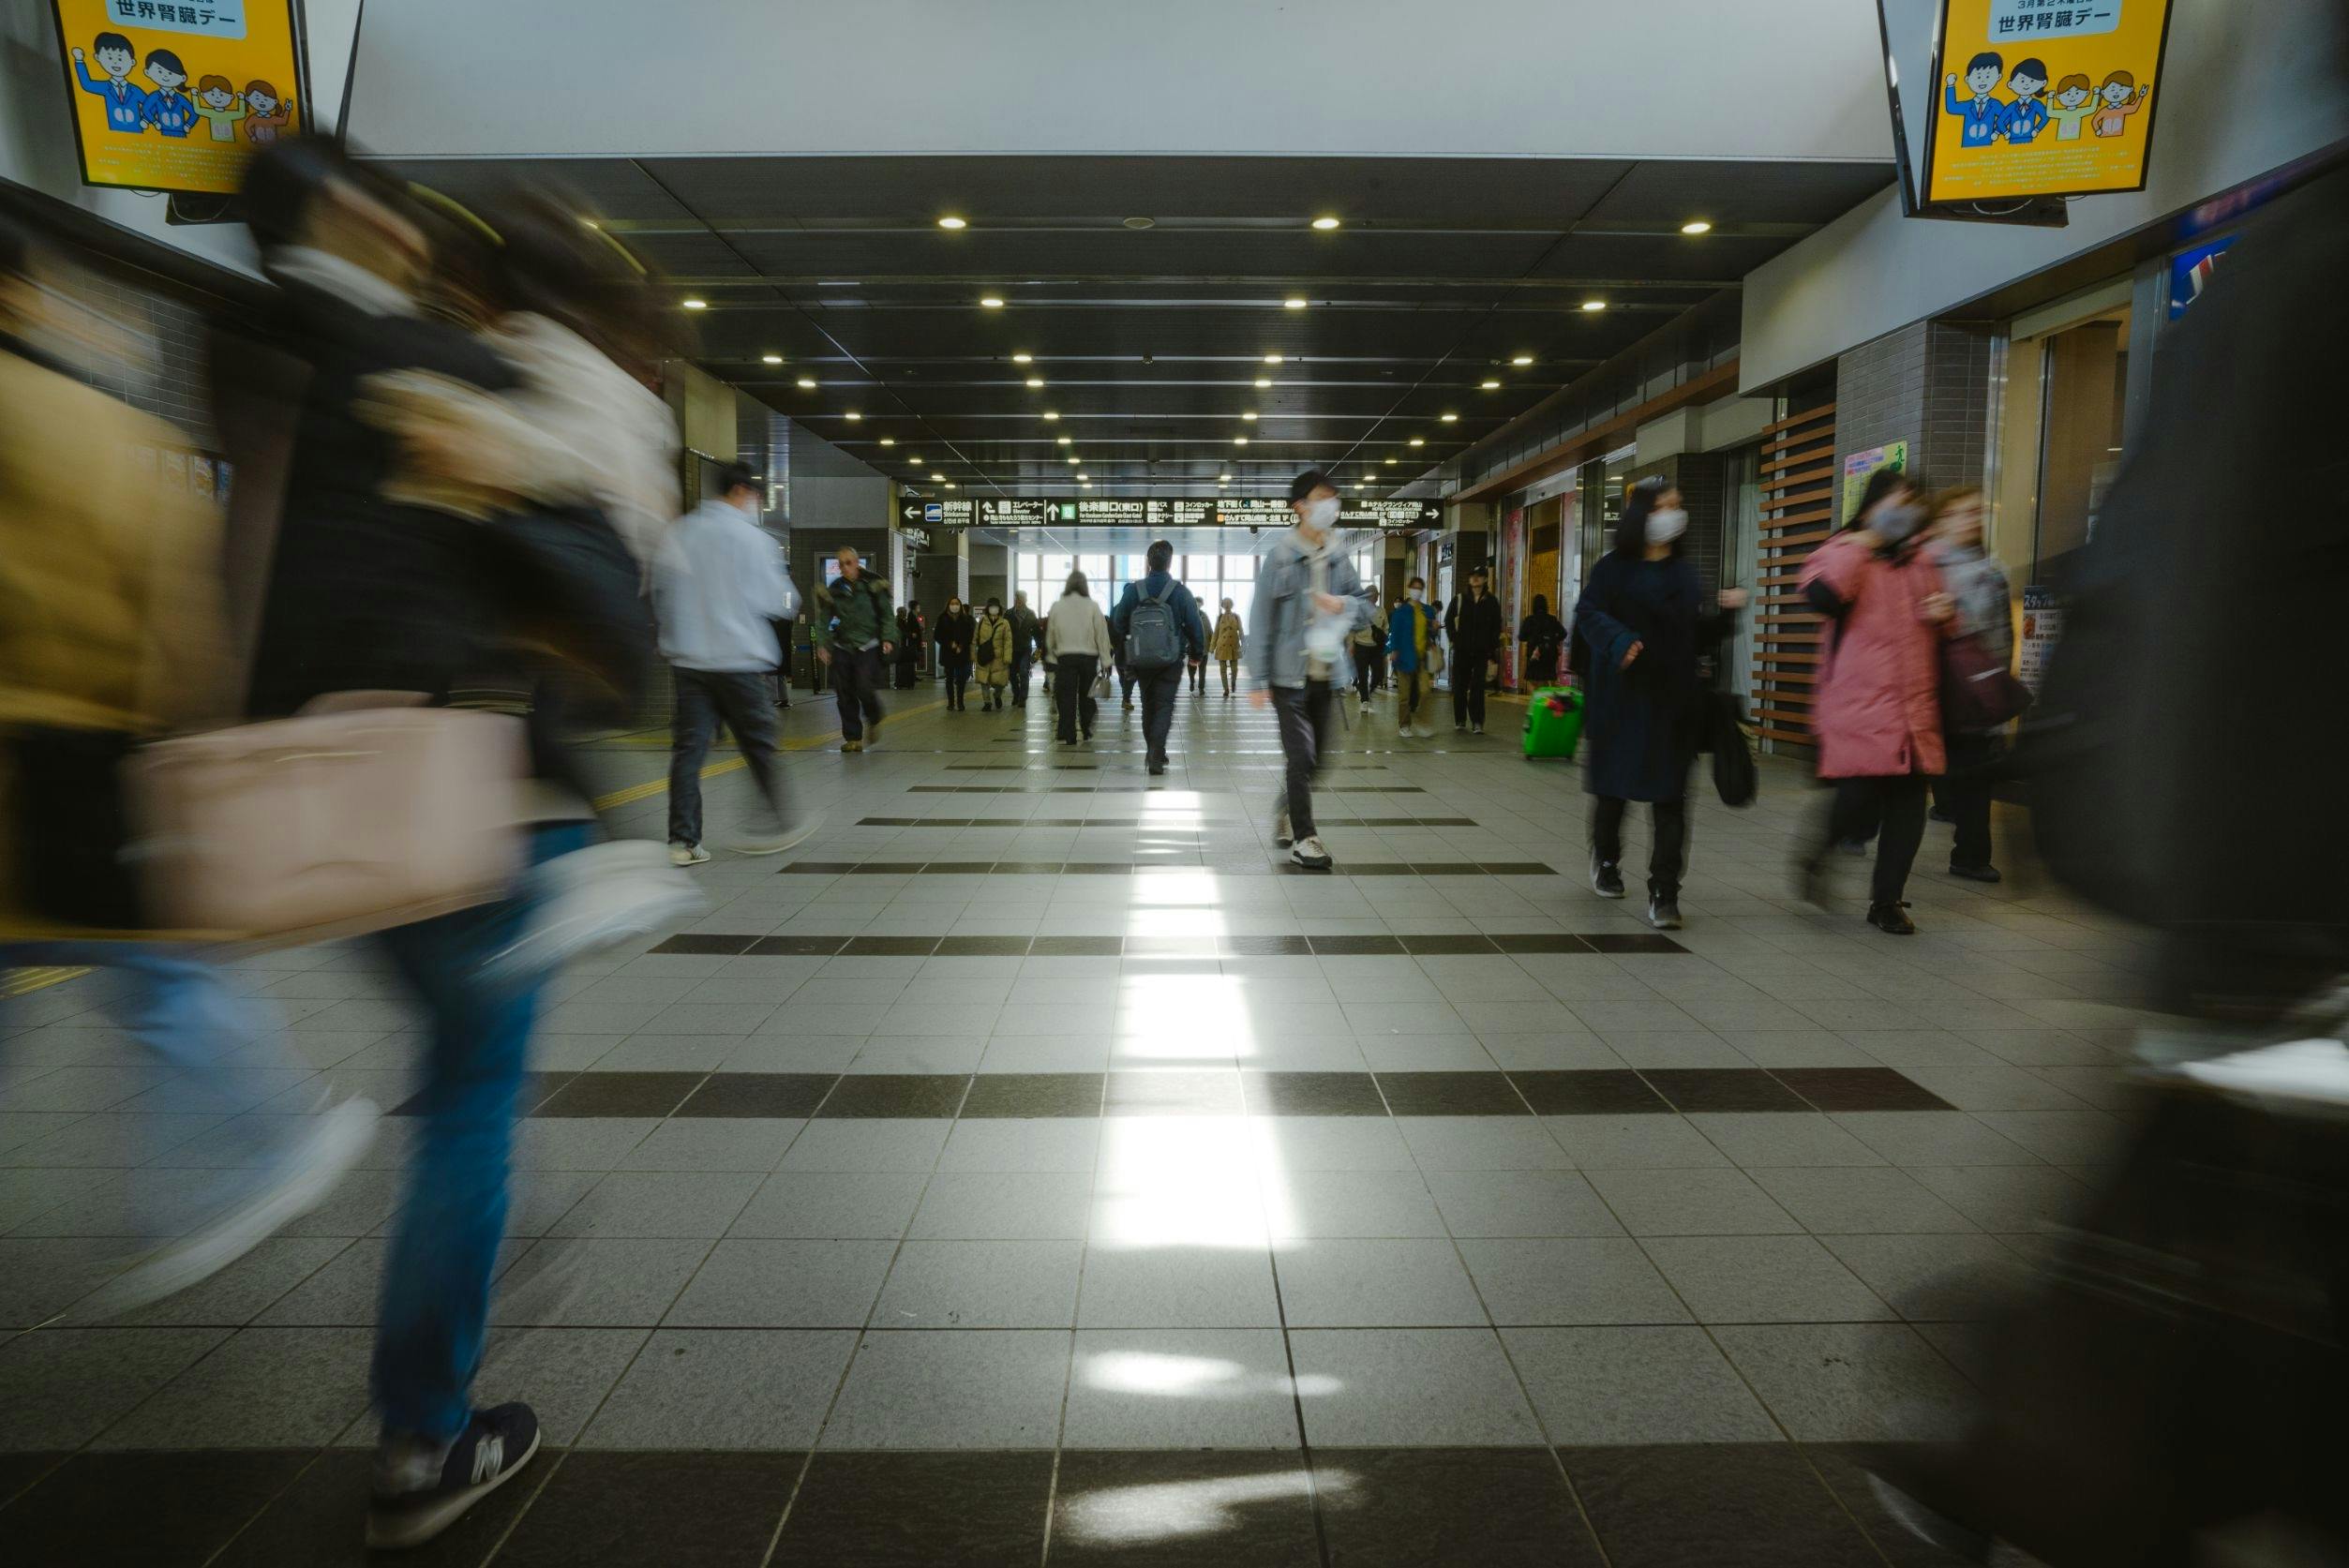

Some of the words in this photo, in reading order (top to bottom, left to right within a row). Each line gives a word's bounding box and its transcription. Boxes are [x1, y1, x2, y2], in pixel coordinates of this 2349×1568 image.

[116, 0, 236, 25] 世界腎臓デー
[1998, 7, 2111, 33] 世界腎臓デー
[943, 501, 971, 512] 新幹線
[1079, 501, 1144, 512] 後楽園口(東口)
